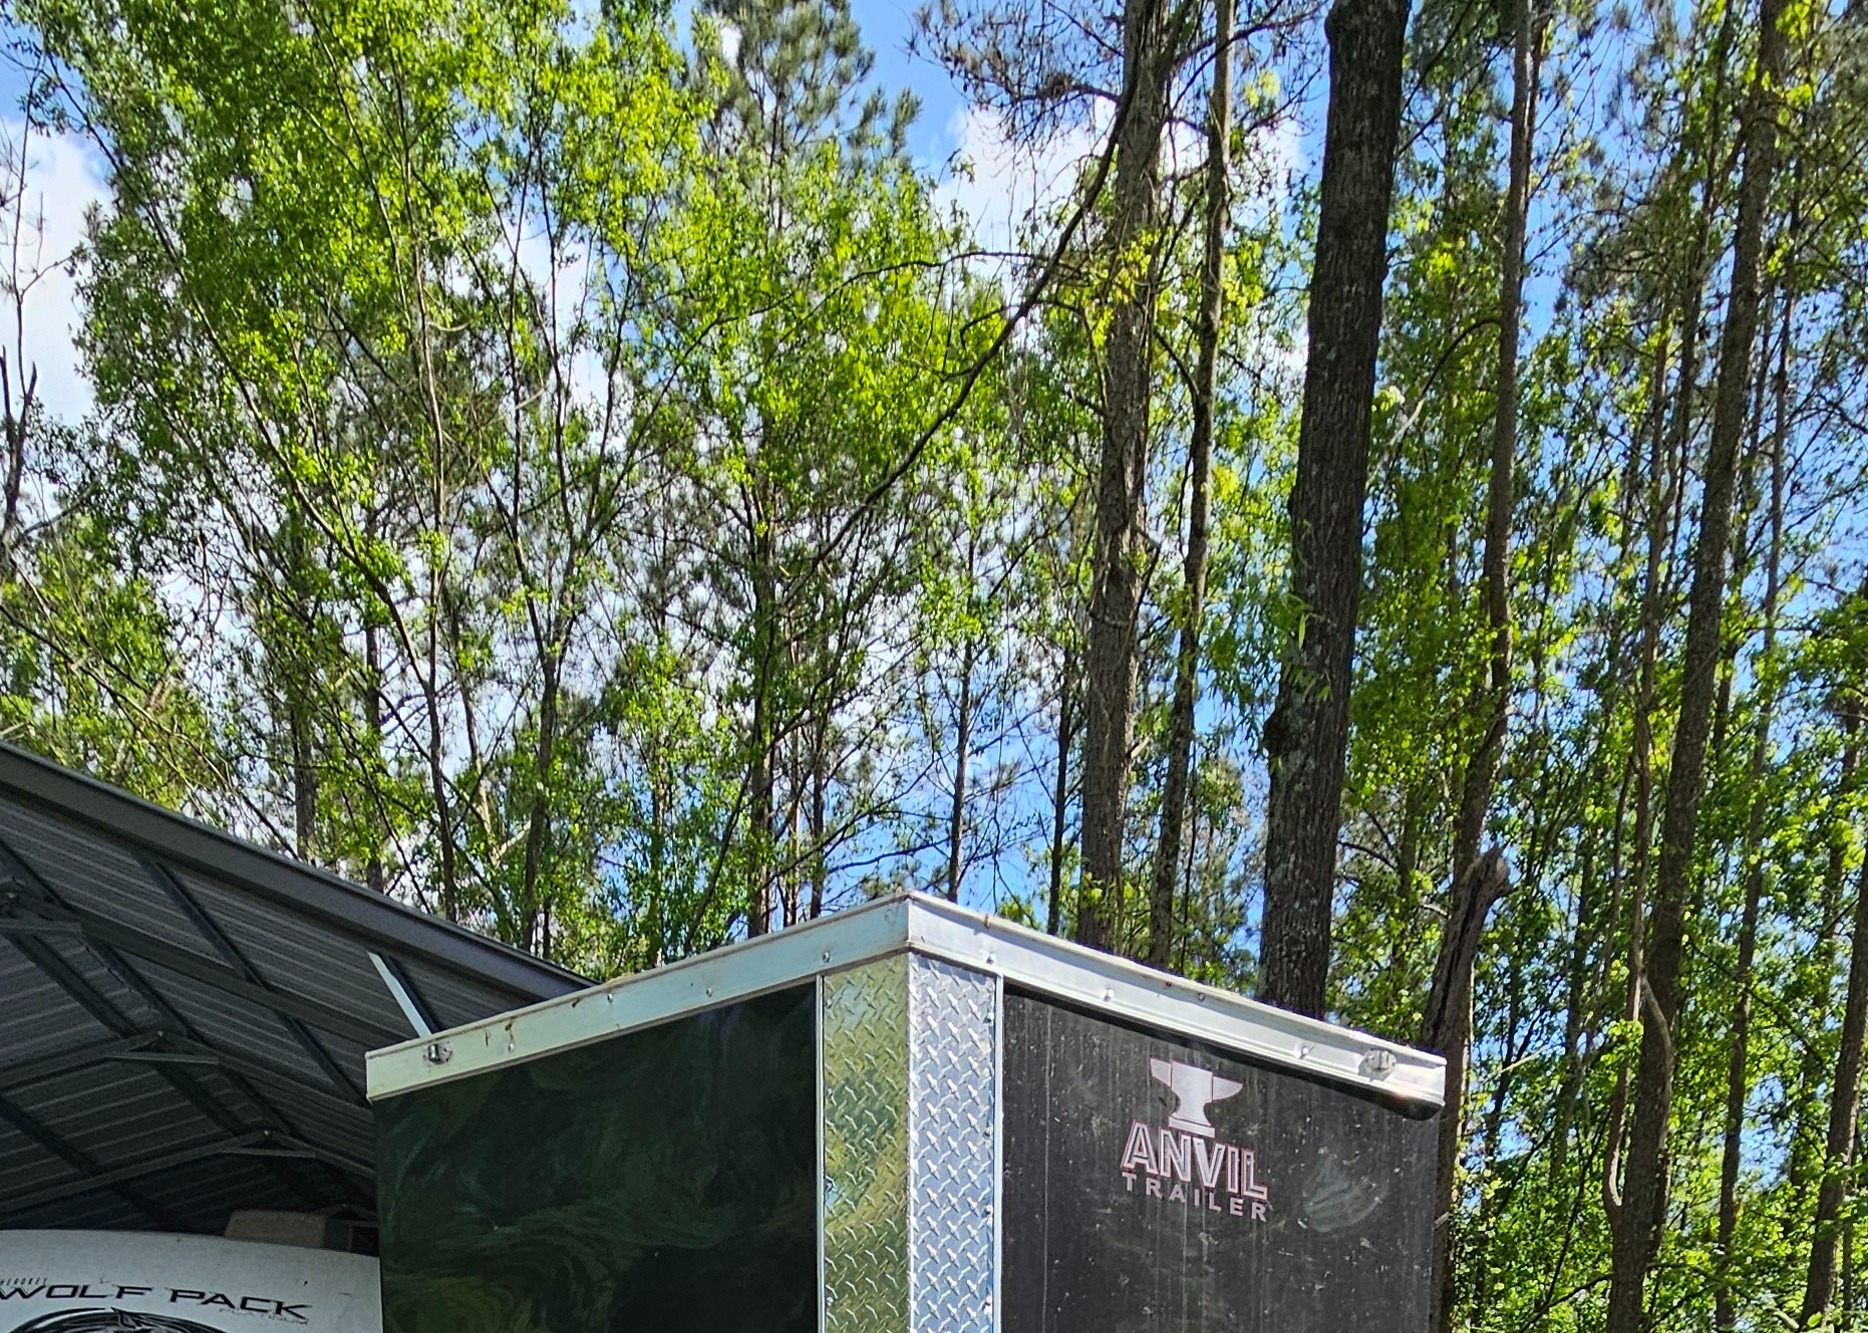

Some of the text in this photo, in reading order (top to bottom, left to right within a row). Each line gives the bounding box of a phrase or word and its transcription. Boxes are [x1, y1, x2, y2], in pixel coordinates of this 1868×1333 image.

[1120, 1120, 1269, 1201] ANVIL
[1122, 1171, 1267, 1222] TRAILER
[0, 1284, 153, 1299] WOLF
[168, 1287, 312, 1321] PACK
